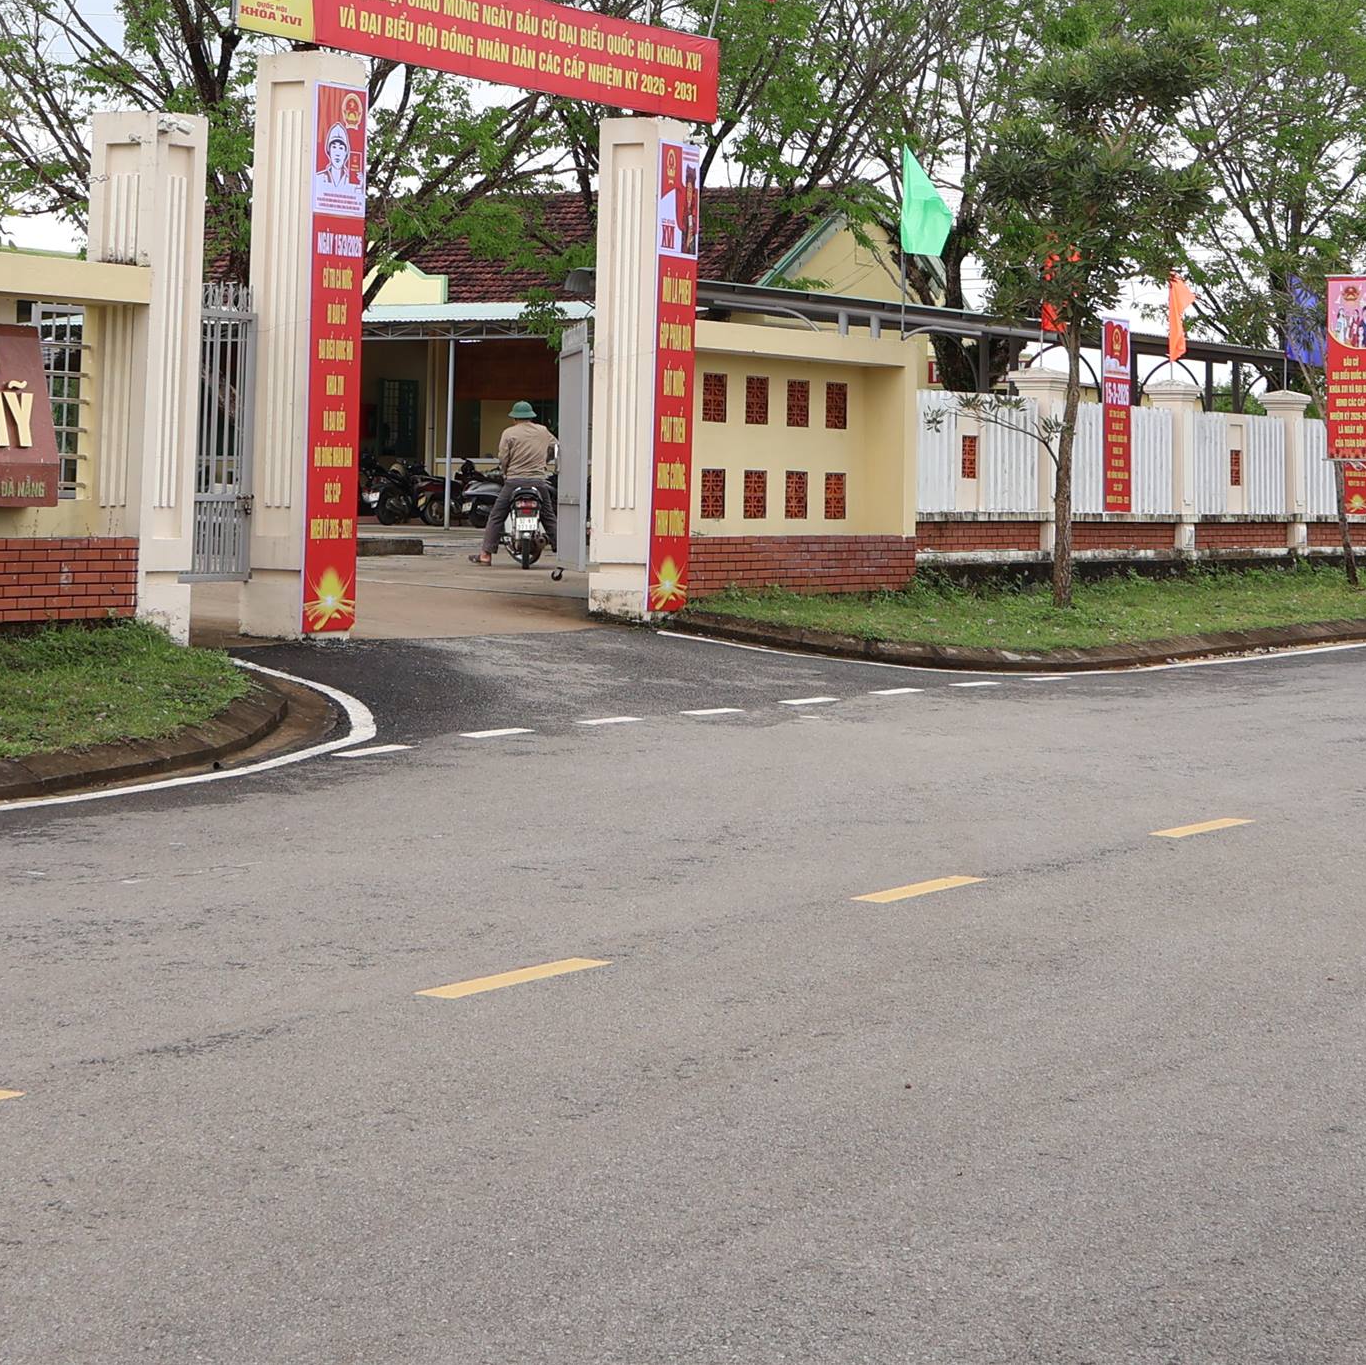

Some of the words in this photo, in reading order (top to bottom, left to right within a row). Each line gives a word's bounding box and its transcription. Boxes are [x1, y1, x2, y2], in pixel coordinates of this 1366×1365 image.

[281, 14, 302, 26] XVI
[483, 3, 513, 29] NGÀY
[541, 14, 557, 40] CỬ
[559, 23, 577, 48] ĐẠI
[581, 23, 604, 51] BIỂU
[607, 31, 635, 57] QUỐC
[637, 39, 654, 65] HỘI
[685, 51, 701, 72] XVI
[339, 4, 356, 29] VÀ
[359, 11, 381, 39] ĐẠI
[385, 12, 413, 43] BIỂU
[417, 23, 437, 51] HỘI
[477, 38, 509, 65] NHÂN
[513, 44, 536, 69] DÂN
[538, 49, 561, 75] CÁC
[563, 53, 585, 79] CẤP
[588, 63, 623, 90] NHIỆM
[625, 68, 639, 91] KỲ
[641, 73, 665, 96] 2026
[674, 81, 697, 103] 2031
[661, 225, 675, 248] XVI
